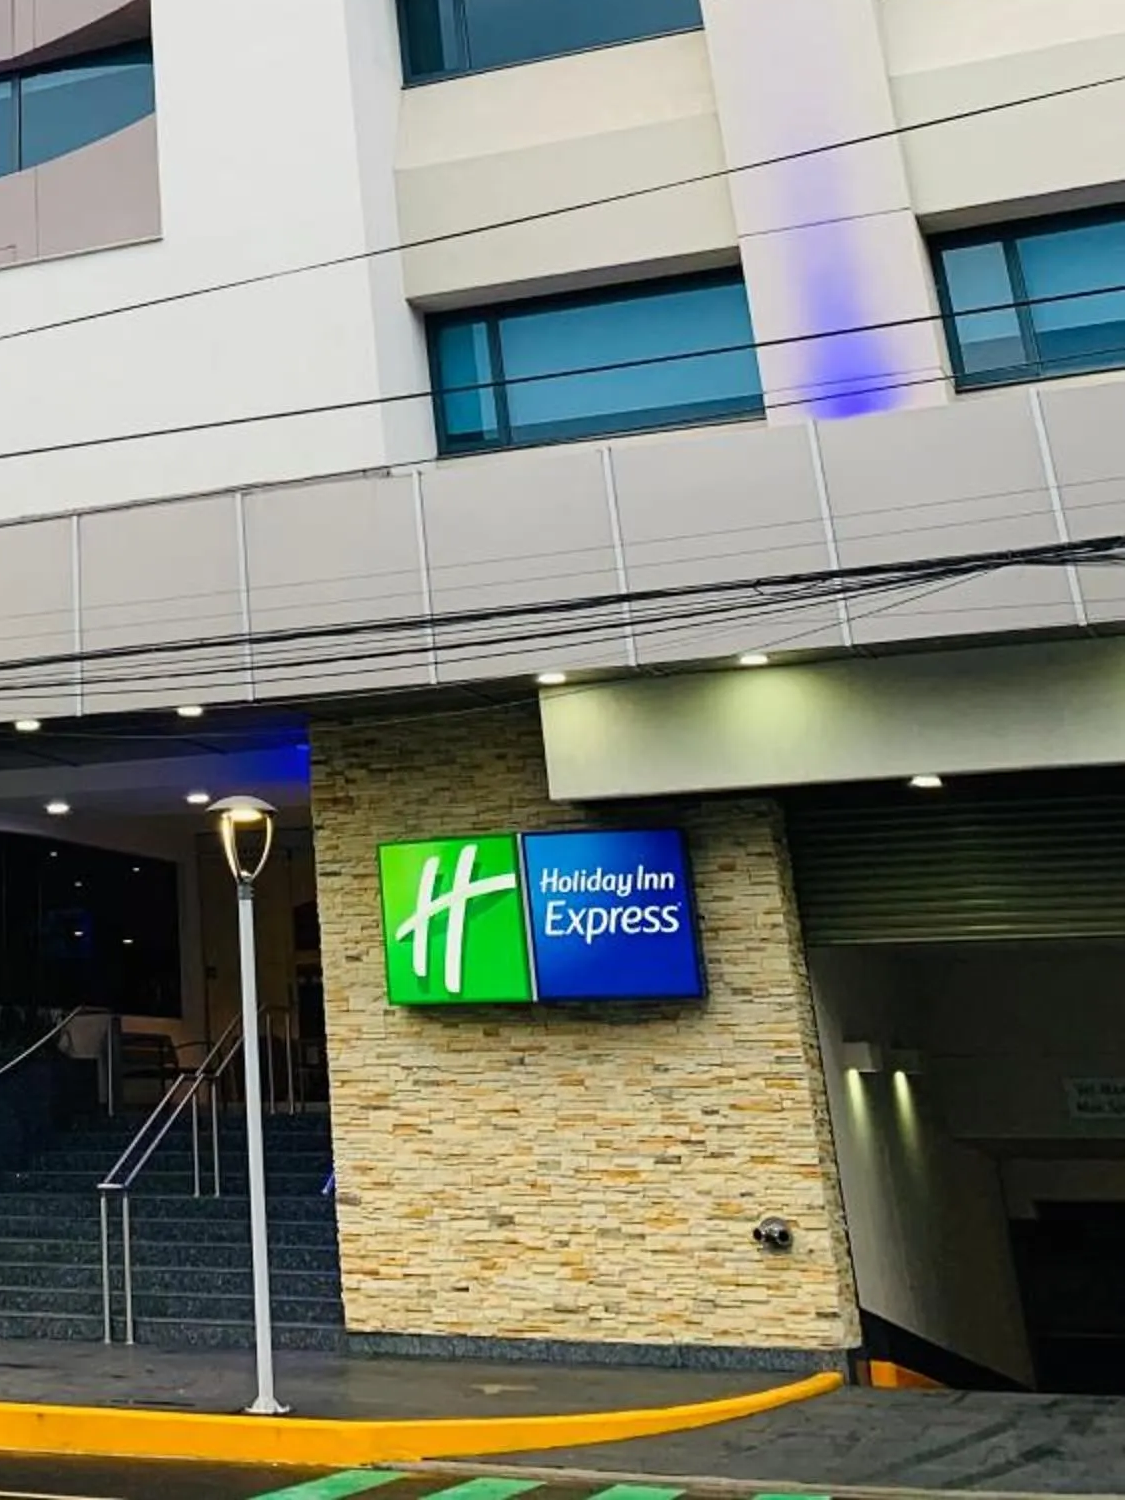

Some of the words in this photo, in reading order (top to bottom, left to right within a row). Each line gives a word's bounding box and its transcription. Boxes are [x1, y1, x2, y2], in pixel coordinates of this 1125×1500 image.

[539, 867, 632, 897] Holiday
[636, 865, 675, 892] Inn
[544, 900, 680, 945] Express
